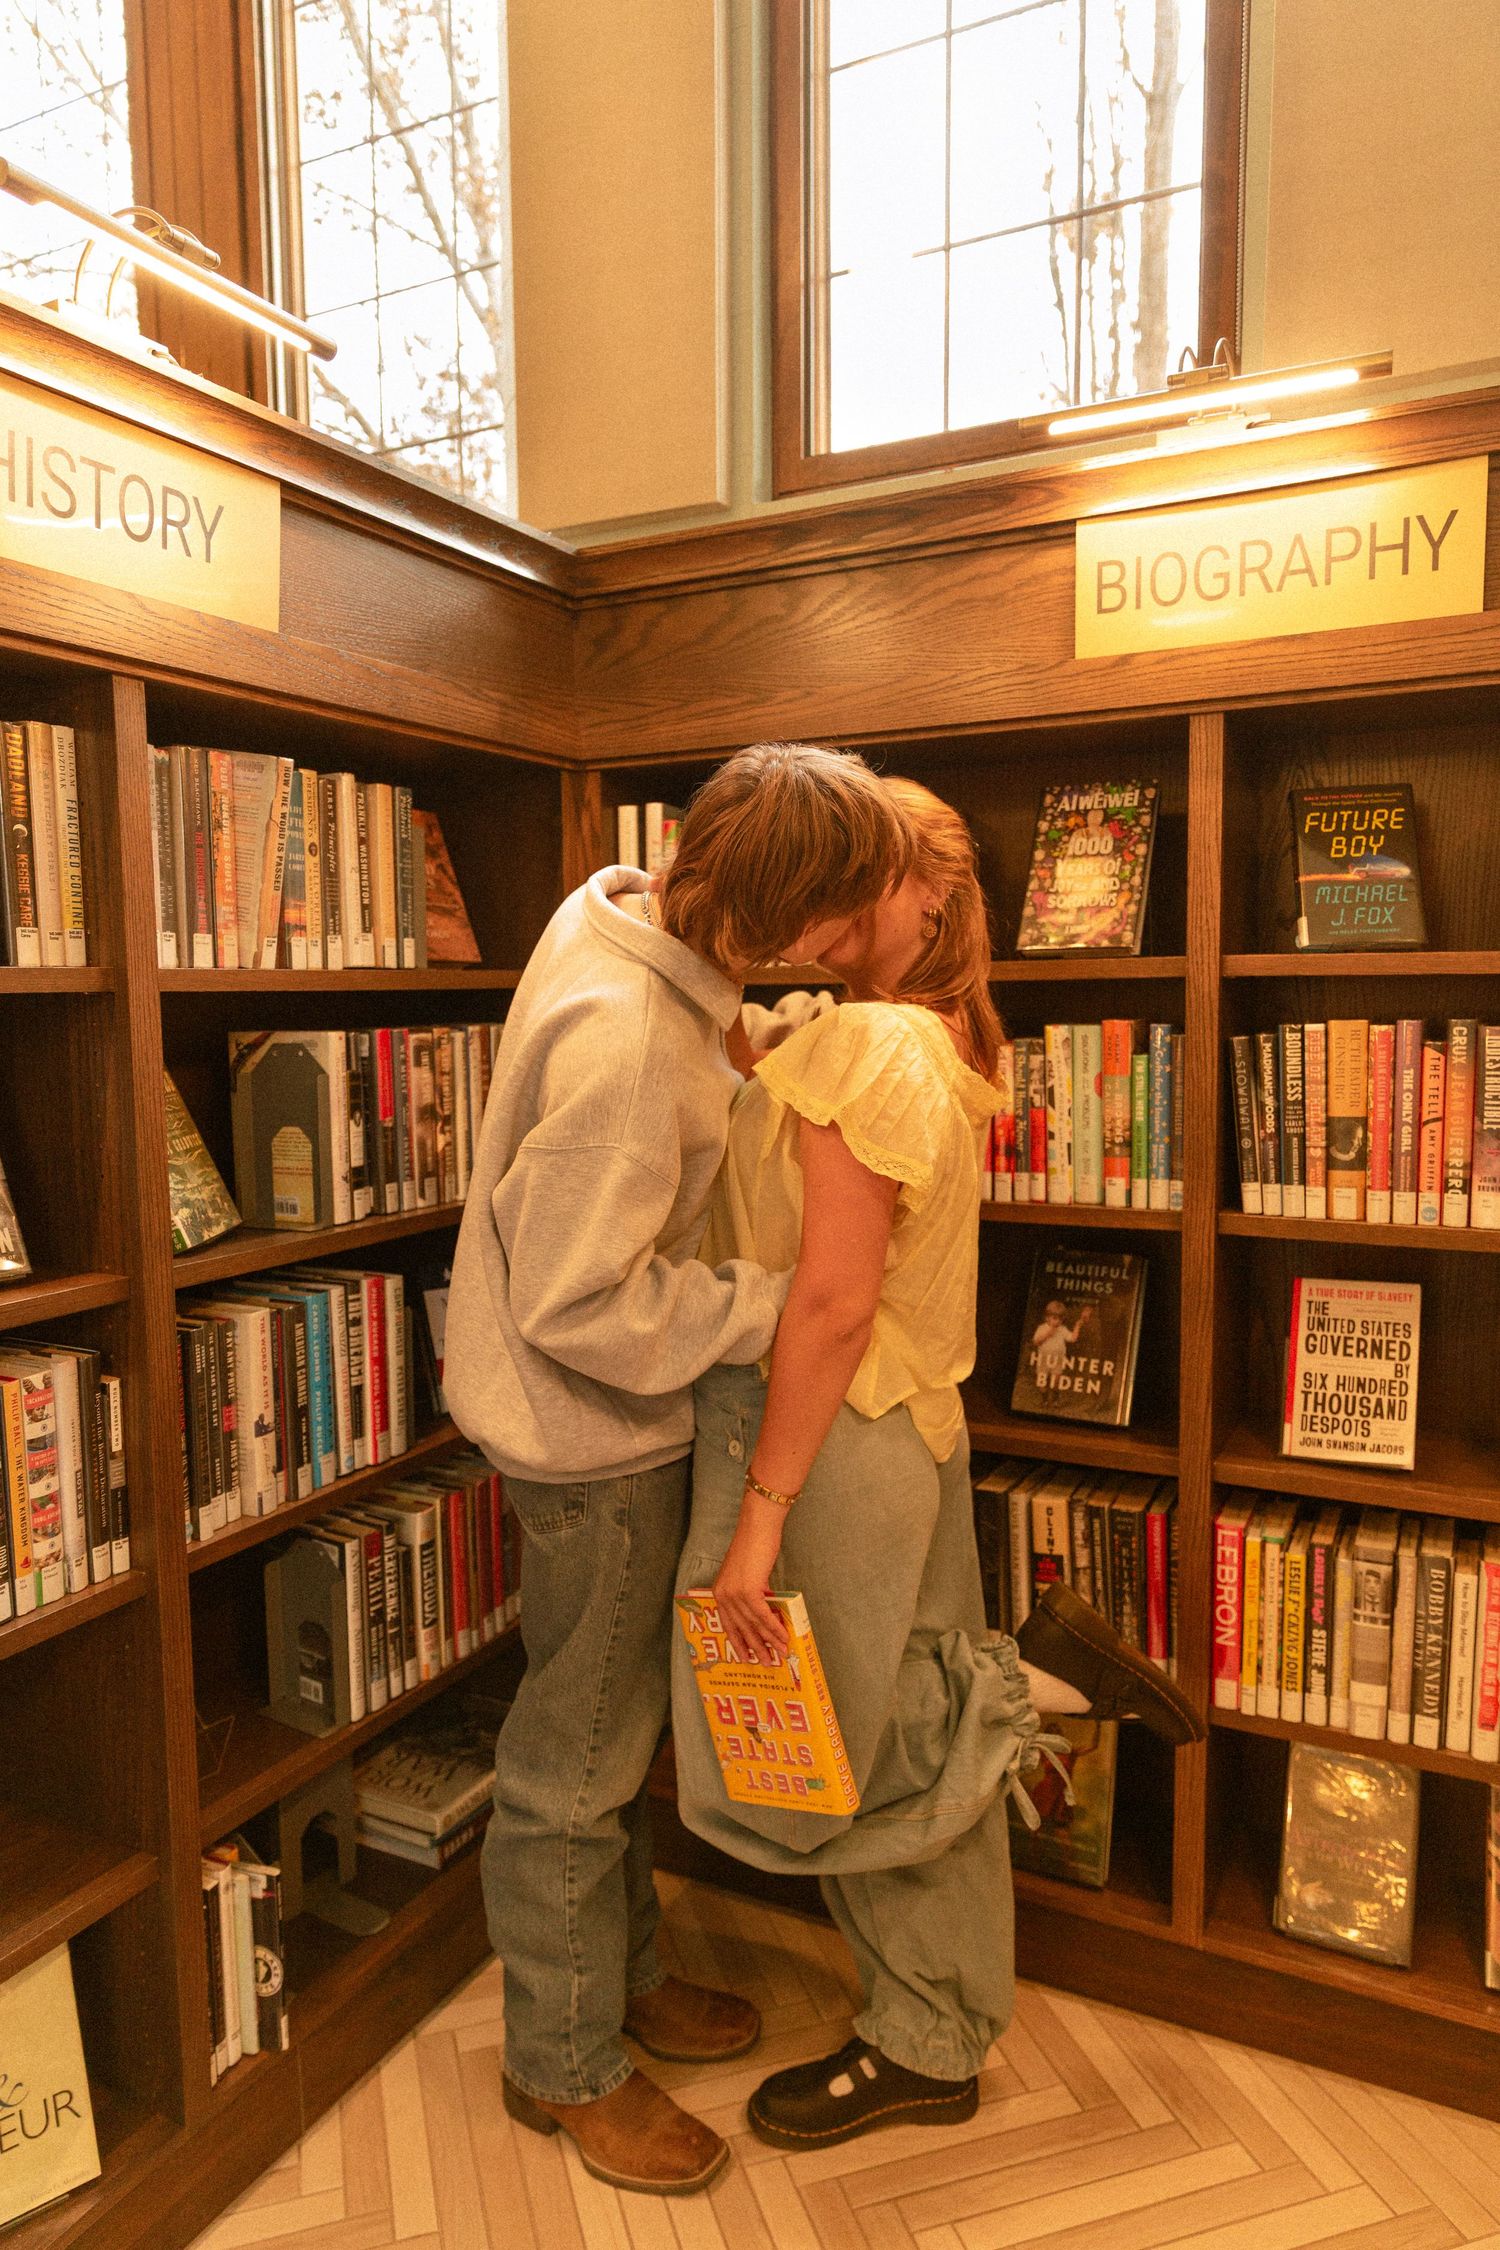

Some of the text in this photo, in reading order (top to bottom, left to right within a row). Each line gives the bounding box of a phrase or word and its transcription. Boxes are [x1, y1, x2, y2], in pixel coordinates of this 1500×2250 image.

[1096, 509, 1460, 615] BIOGRAPHY
[6, 732, 28, 818] DADLAND
[57, 737, 66, 790] DROZDIAK
[220, 760, 228, 789] FOUR
[283, 766, 291, 789] HOW
[281, 791, 289, 808] THE
[1057, 789, 1140, 812] AI WEIWEI
[66, 799, 80, 868] FRACTURED
[221, 795, 231, 849] HUNDRED
[278, 812, 287, 839] WORD
[1305, 808, 1405, 833] FUTURE
[277, 843, 285, 852] IS
[328, 822, 336, 872] Principles
[357, 792, 369, 905] FRANKLIN WASHINGTON
[1067, 836, 1114, 855] 1000
[1331, 835, 1384, 858] BOY
[16, 853, 30, 894] KEGGIE
[224, 855, 232, 891] SOULS
[273, 856, 283, 891] PASSED
[1047, 893, 1118, 909] SORROWS
[1316, 884, 1408, 904] MICHAEL
[1331, 906, 1395, 926] J. FOX
[1452, 1027, 1467, 1064] CRUX
[1154, 1051, 1162, 1076] Crafts
[1286, 1033, 1302, 1101] BOUNDLESS
[1309, 1033, 1321, 1093] RISE OF A
[1335, 1037, 1345, 1099] GINSBURG
[1350, 1029, 1361, 1108] RUTH BADER
[1403, 1069, 1414, 1089] THE
[1016, 1055, 1026, 1116] Should Have
[1136, 1076, 1144, 1096] STILL
[1155, 1078, 1163, 1090] for
[1235, 1060, 1250, 1132] STOWAWAY
[1263, 1043, 1275, 1134] MADMAN WOODS
[1428, 1056, 1440, 1116] THE TELL
[1450, 1072, 1465, 1112] JEAN
[1483, 1035, 1500, 1130] INDESTRUCTIBLE
[1104, 1083, 1112, 1149] CALIFORNIA
[1114, 1094, 1123, 1143] BROWNS
[1136, 1100, 1145, 1121] HERE
[1402, 1093, 1412, 1122] ONLY
[1402, 1126, 1412, 1152] GIRL
[1427, 1129, 1436, 1191] AMY GRIFFIN
[1045, 1262, 1129, 1281] BEAUTIFUL
[1056, 1278, 1114, 1294] THINGS
[348, 1294, 362, 1321] THE
[1307, 1301, 1329, 1315] THE
[1308, 1288, 1413, 1302] A TRUE STORY OF SLAVERY
[394, 1288, 403, 1356] COMPROMISED
[1307, 1316, 1412, 1339] UNITED STATES
[225, 1332, 234, 1349] PAY
[350, 1326, 364, 1386] BREACH
[1305, 1333, 1411, 1361] GOVERNED
[226, 1352, 234, 1369] ANY
[294, 1323, 308, 1408] AMERICAN CARNAGE
[313, 1339, 321, 1382] LEONNIG
[1030, 1351, 1115, 1376] HUNTER
[1395, 1363, 1410, 1379] BY
[211, 1389, 217, 1398] IN
[227, 1372, 236, 1399] PRICE
[261, 1375, 268, 1387] AS
[263, 1389, 269, 1398] IT
[1035, 1372, 1101, 1395] BIDEN
[1303, 1372, 1409, 1397] SIX HUNDRED
[94, 1392, 102, 1424] Beyond
[264, 1401, 270, 1410] IS
[1301, 1391, 1407, 1421] THOUSAND
[1301, 1414, 1371, 1437] DESPOTS
[1300, 1437, 1405, 1455] JOHN SWANSON JACOBS
[11, 1392, 28, 1547] PHILIP BALL THE WATER KINGDOM
[367, 1556, 382, 1617] PERIL
[384, 1534, 399, 1624] INTERFERENCE
[422, 1547, 437, 1625] THEROUX
[1289, 1561, 1300, 1597] LESLIE
[1314, 1548, 1325, 1593] LONELY
[1215, 1529, 1238, 1647] LEBRON
[1311, 1629, 1327, 1667] STEVE
[1414, 1609, 1425, 1670] LARRY TYE
[1423, 1569, 1446, 1719] BOBBY KENNEDY
[1459, 1628, 1467, 1657] Married
[758, 1683, 788, 1691] FLORIDA
[1286, 1655, 1299, 1692] JONES
[1457, 1676, 1465, 1708] Harrison
[702, 1693, 811, 1733] EVER.
[716, 1734, 815, 1768] STATE.
[822, 1705, 858, 1808] DAVE BARRY
[736, 1767, 809, 1797] BEST.
